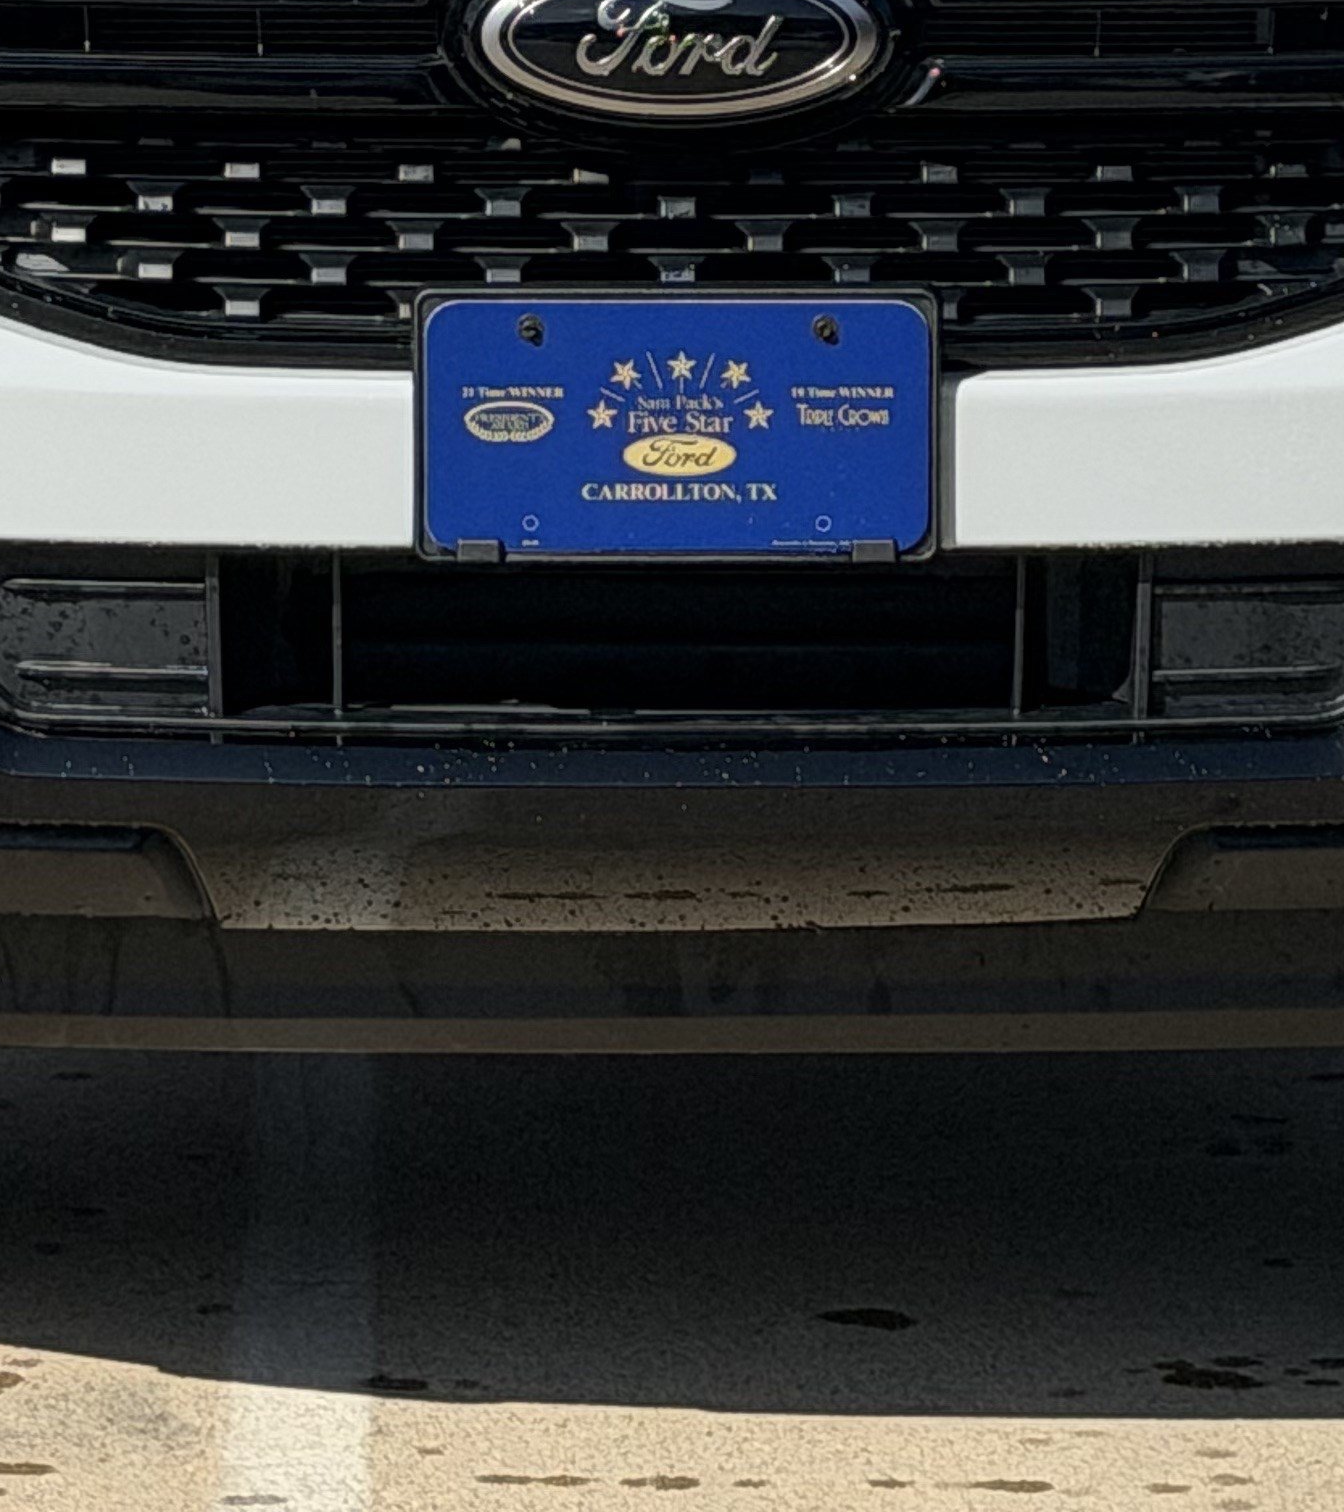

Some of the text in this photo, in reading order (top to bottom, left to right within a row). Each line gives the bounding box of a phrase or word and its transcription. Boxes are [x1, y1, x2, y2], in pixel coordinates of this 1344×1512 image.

[506, 386, 564, 399] WINNER
[838, 386, 894, 399] WINNER
[637, 394, 670, 411] Sam
[627, 410, 734, 434] Five Star
[641, 437, 718, 468] Ford
[581, 483, 778, 503] CARROLLTON, TX
